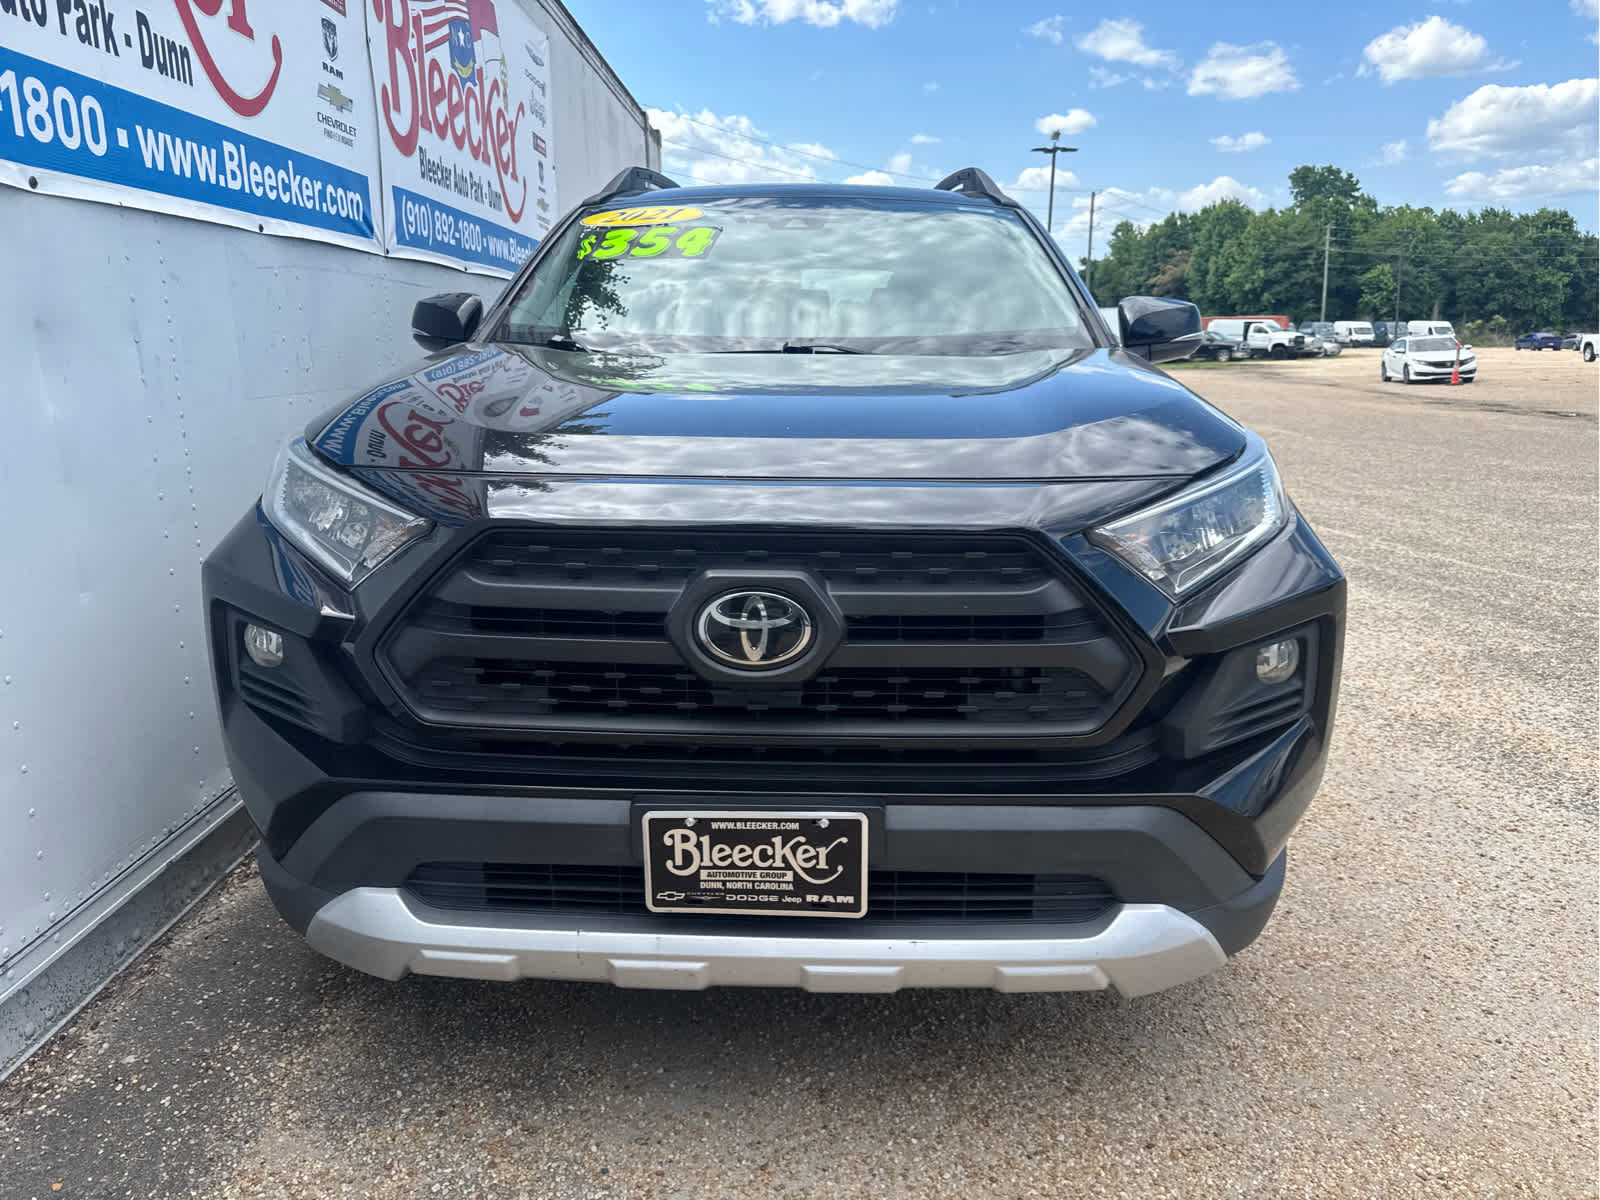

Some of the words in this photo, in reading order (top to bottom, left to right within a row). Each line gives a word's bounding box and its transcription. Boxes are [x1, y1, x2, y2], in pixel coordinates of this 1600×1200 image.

[135, 10, 194, 87] Dunn
[321, 61, 344, 80] RAM
[317, 111, 357, 137] CHEVROLET
[372, 0, 526, 224] Bleecker
[0, 69, 107, 156] 1800
[135, 124, 364, 222] www.Bleecker.com
[418, 145, 452, 194] Bleecker
[453, 163, 469, 198] Auto
[469, 171, 485, 205] Park
[401, 194, 433, 246] (910)
[433, 210, 482, 253] 892-1800
[602, 208, 684, 223] 2021
[577, 227, 715, 260] $354
[710, 821, 800, 831] WWW.BLEECKER.COM
[663, 828, 849, 885] Bleecker
[700, 881, 725, 890] DUNN,
[726, 882, 753, 890] NORTH
[754, 882, 794, 891] CAROLINA
[706, 871, 757, 880] AUTOMOTIVE
[759, 872, 788, 880] GROUP
[725, 894, 780, 902] DODGE
[781, 895, 802, 904] Jeep
[806, 894, 855, 904] RAM
